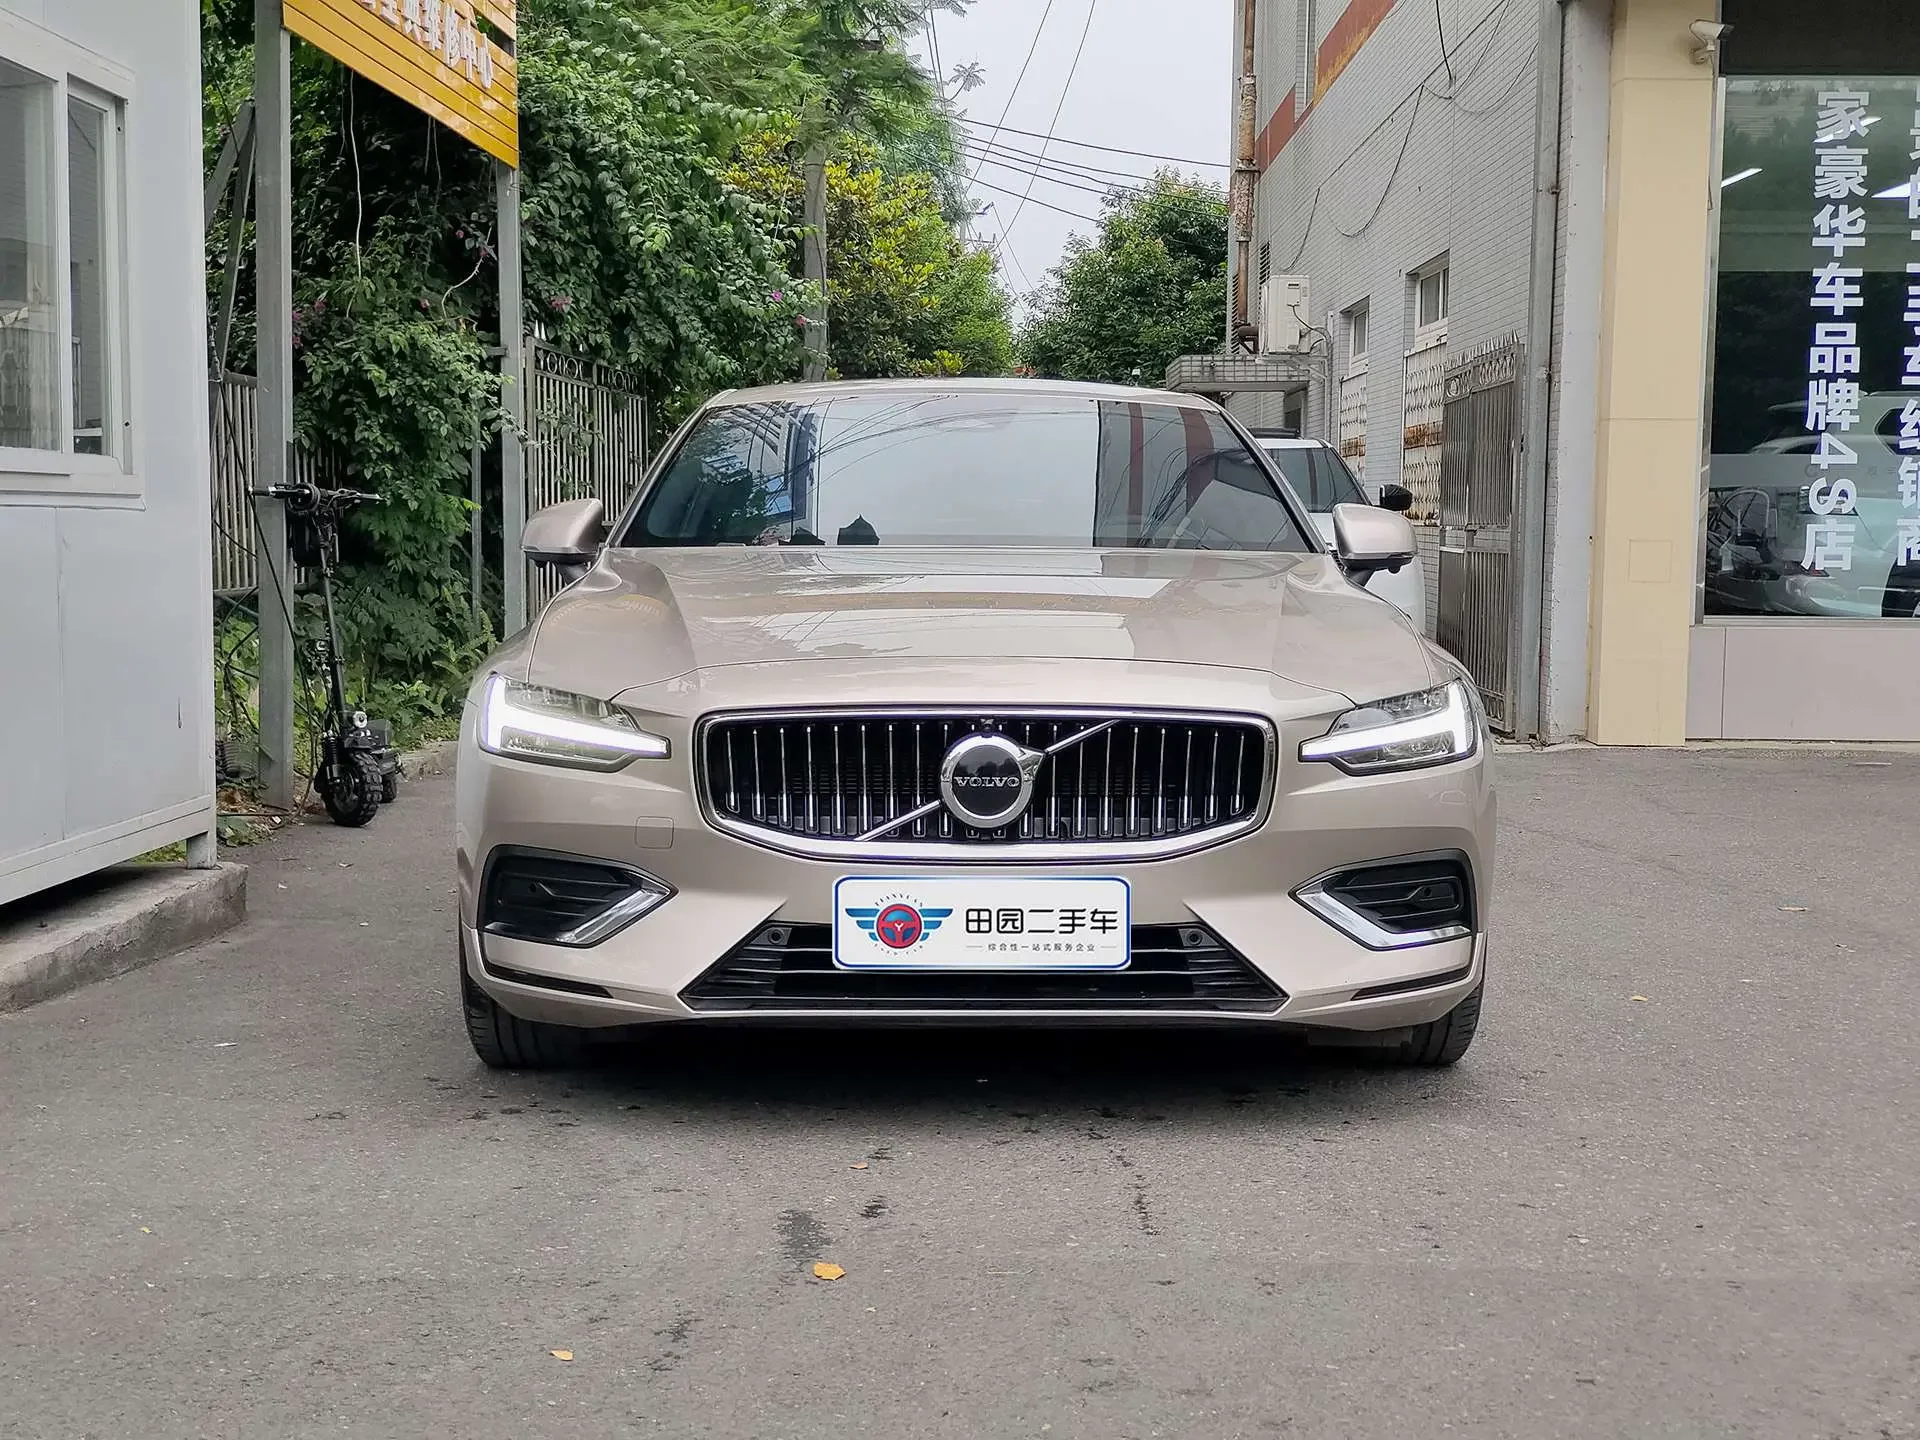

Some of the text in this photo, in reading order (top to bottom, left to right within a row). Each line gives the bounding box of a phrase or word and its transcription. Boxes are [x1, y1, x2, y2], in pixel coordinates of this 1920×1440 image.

[1801, 87, 1870, 571] 家豪华车品牌4S店
[953, 776, 1020, 787] VOLVO
[965, 908, 1118, 934] 田园二手车
[987, 943, 1096, 952] 综合性一站式服务企业
